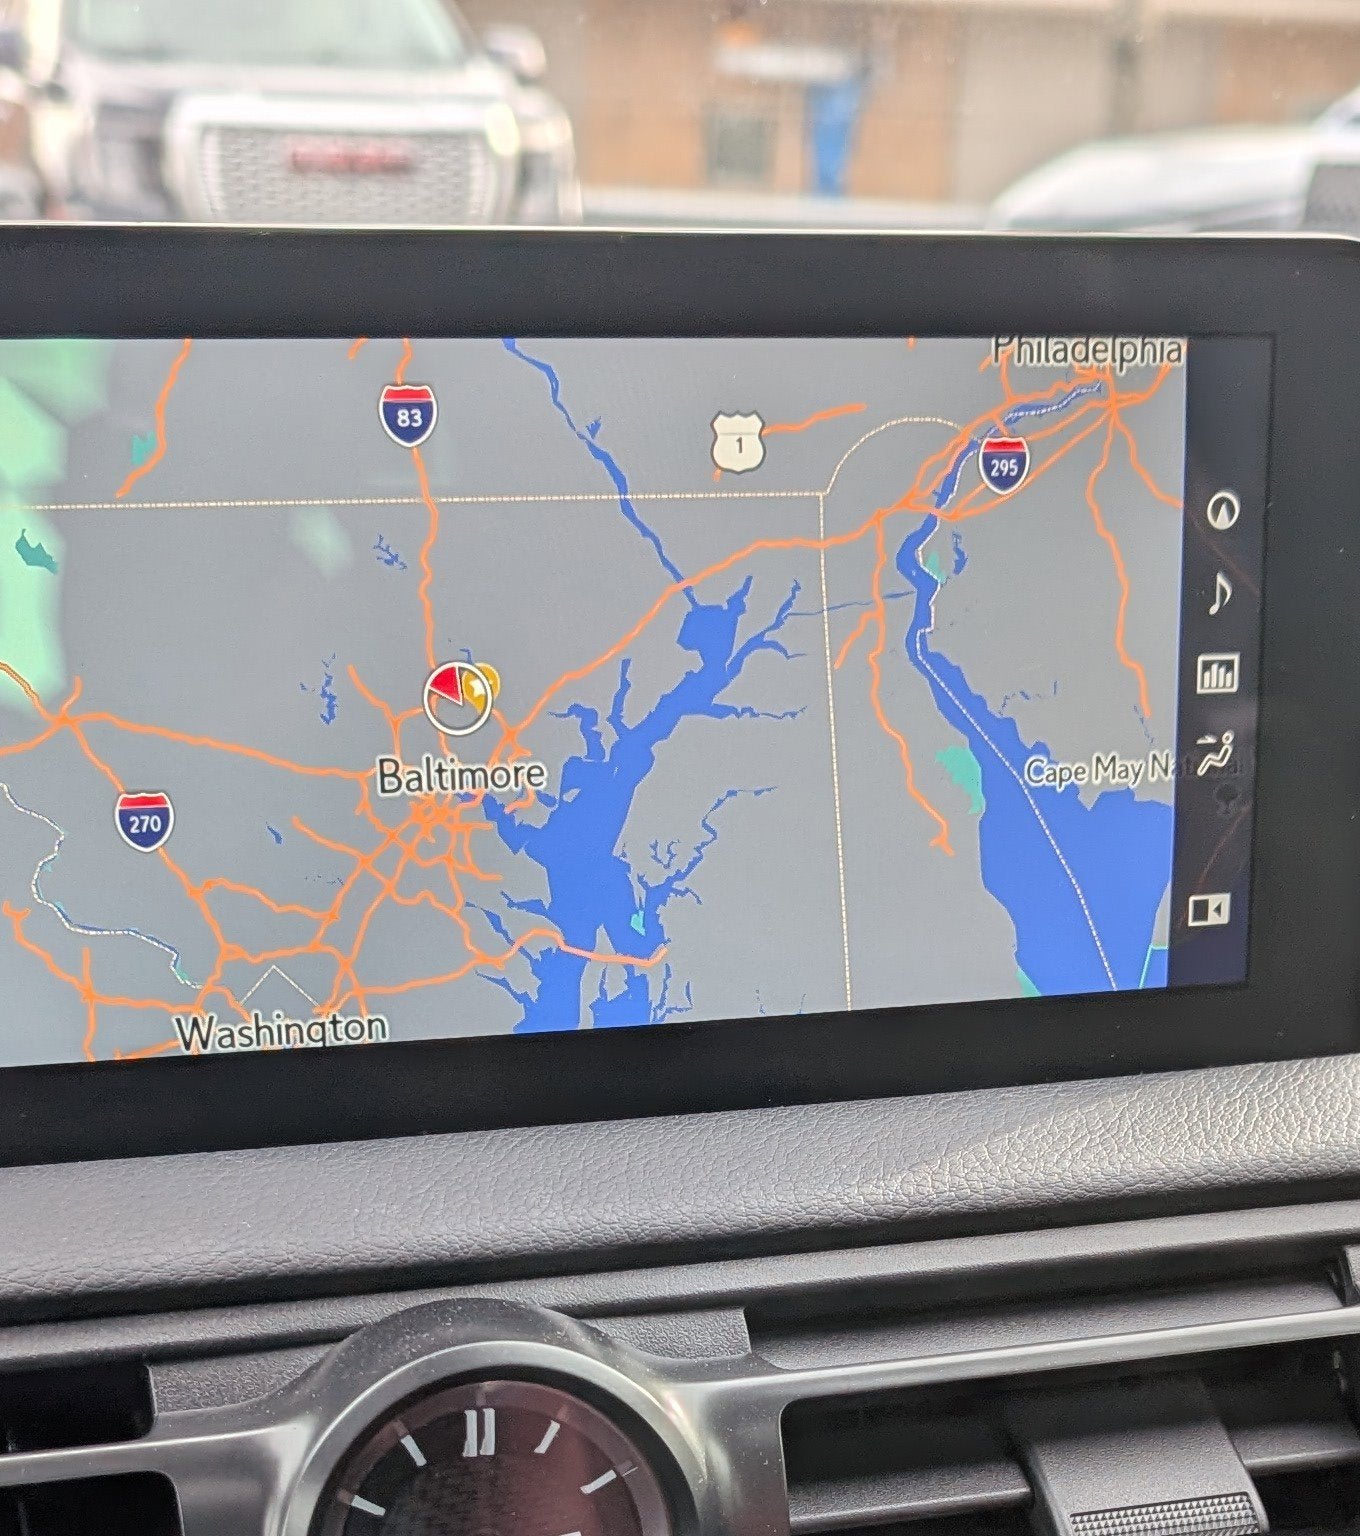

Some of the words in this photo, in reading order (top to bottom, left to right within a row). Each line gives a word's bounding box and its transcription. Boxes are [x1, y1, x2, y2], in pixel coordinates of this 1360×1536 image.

[994, 335, 1183, 374] Philadelphia
[396, 408, 423, 428] 83
[735, 436, 745, 454] 1
[990, 458, 1019, 477] 295
[377, 758, 545, 795] Baltimore
[1026, 757, 1088, 791] Cape
[1094, 754, 1143, 786] May
[128, 814, 162, 834] 270
[175, 1014, 387, 1052] Washington
